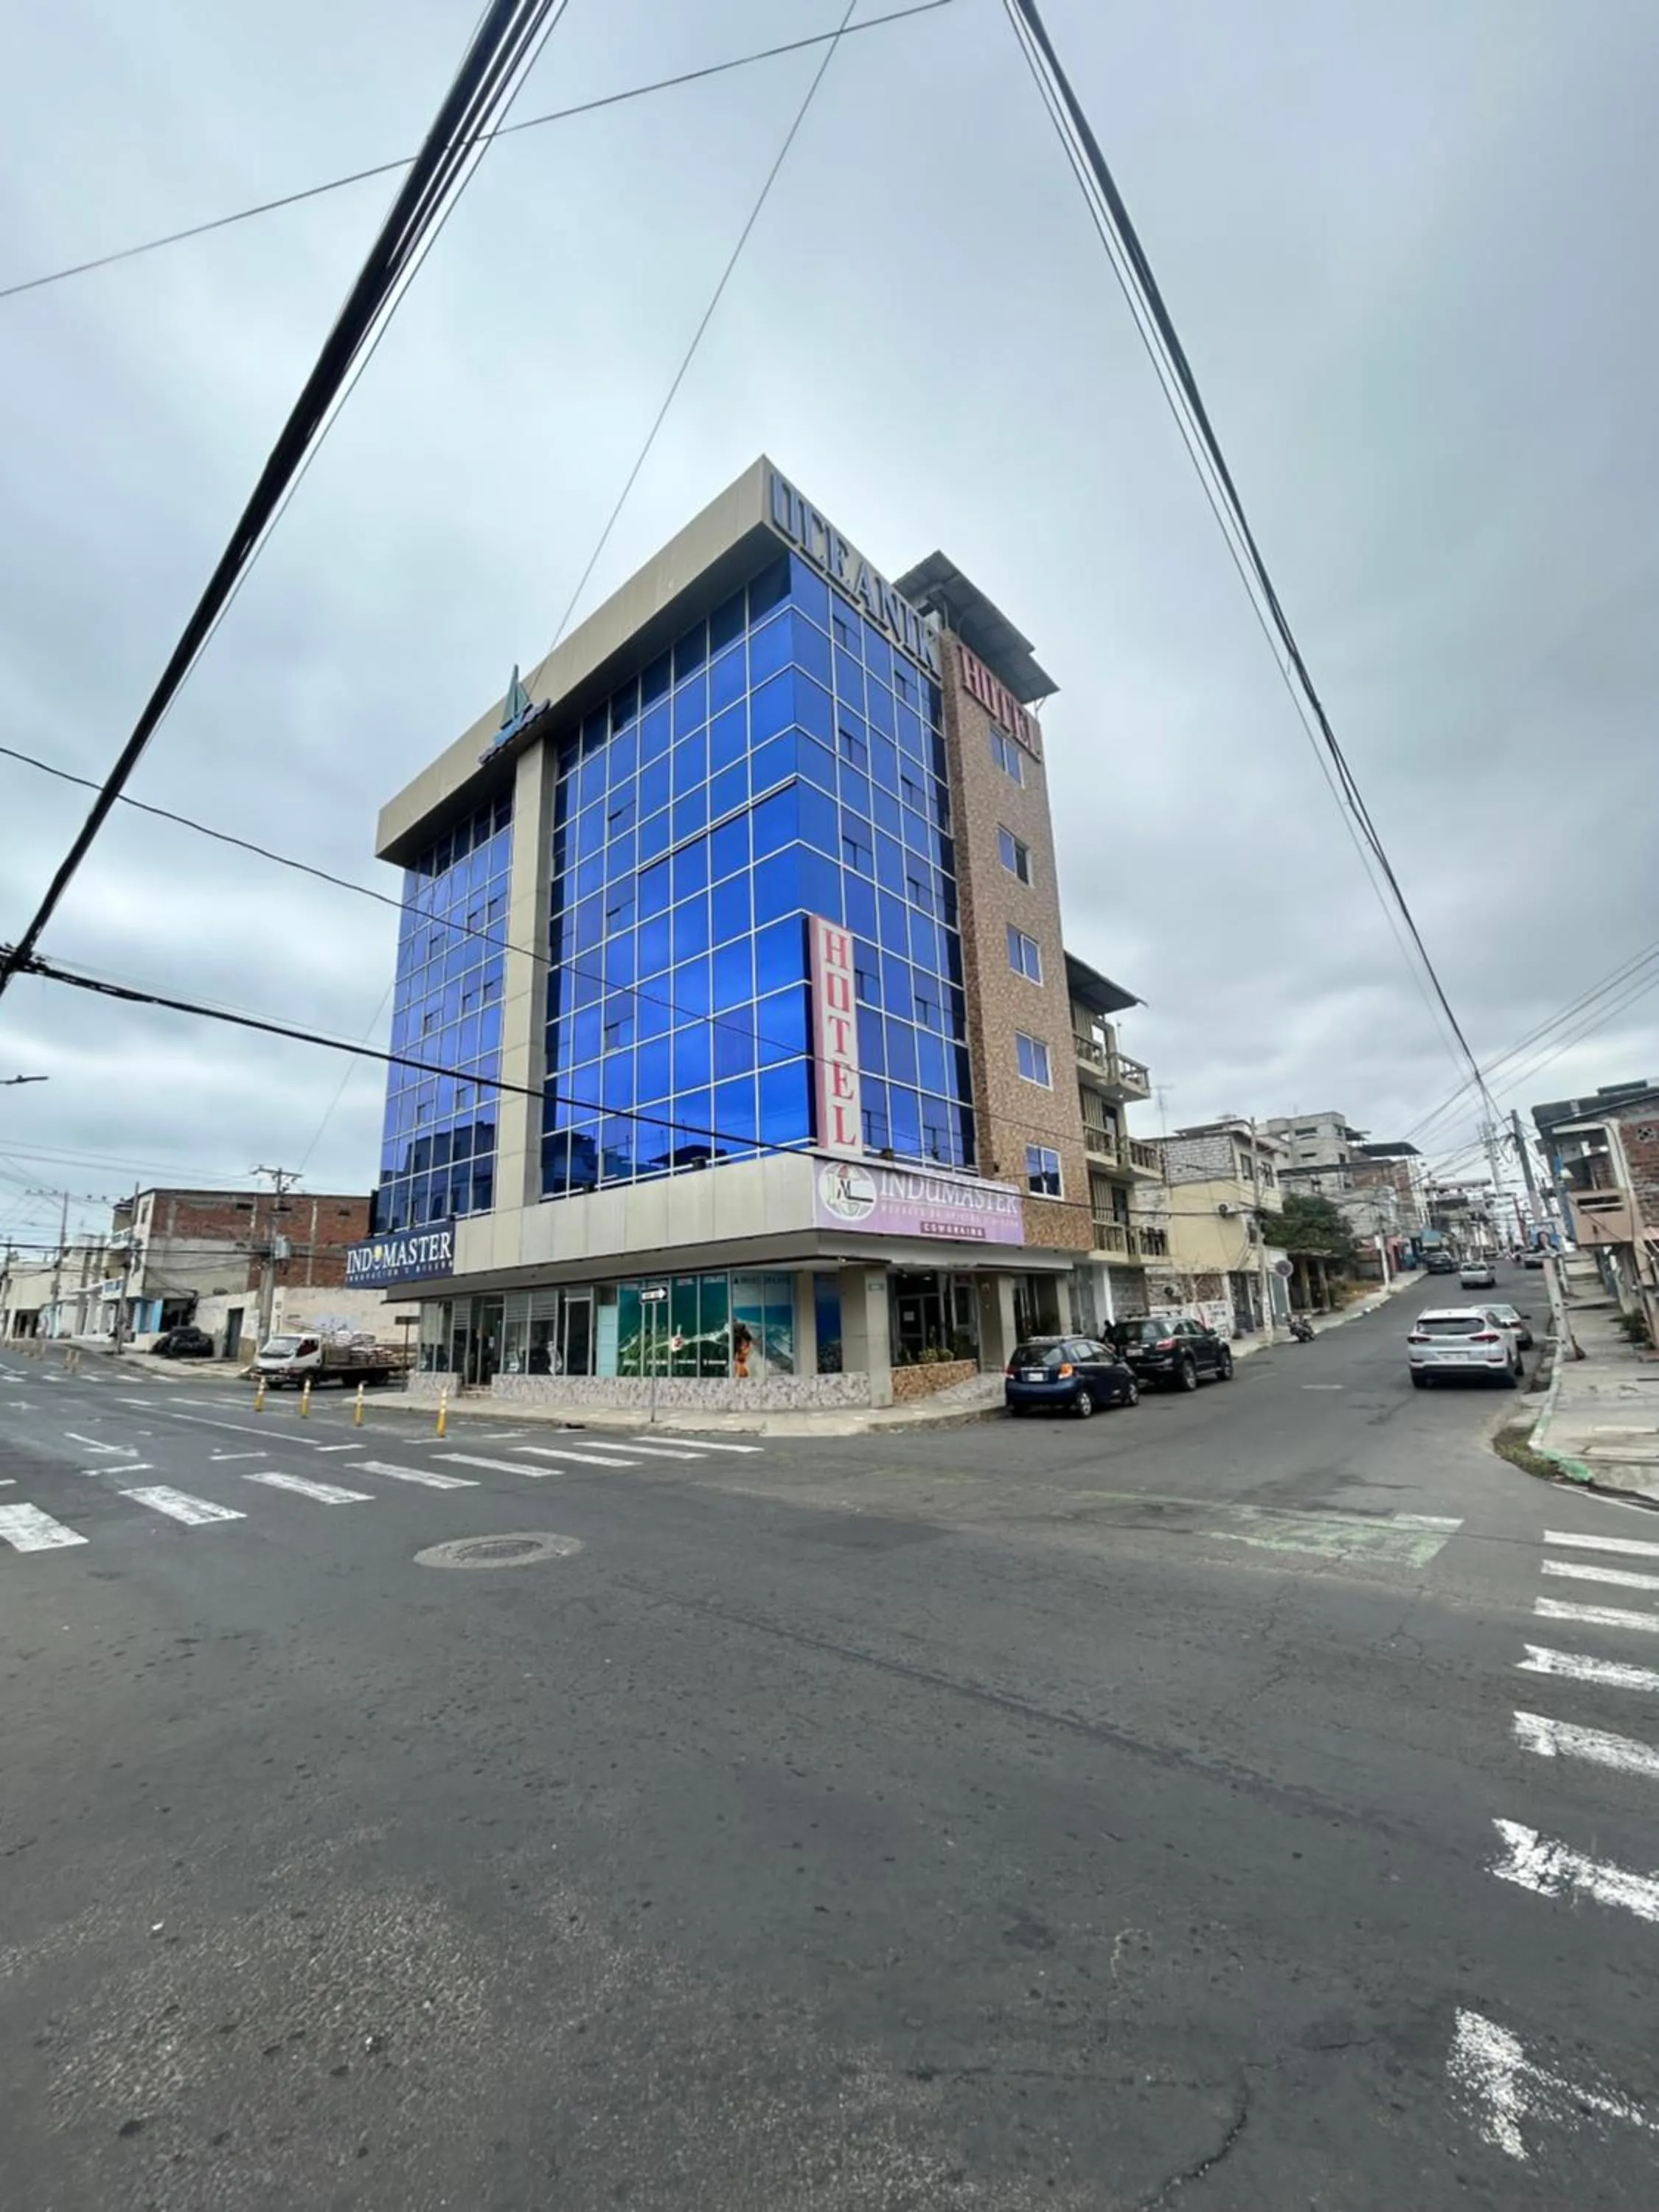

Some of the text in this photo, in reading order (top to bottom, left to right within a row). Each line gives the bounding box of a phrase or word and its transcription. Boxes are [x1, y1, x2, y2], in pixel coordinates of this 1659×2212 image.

[957, 643, 1041, 762] HOTEL
[822, 926, 858, 1148] HOTEL
[880, 1171, 1019, 1216] INDUMASTER
